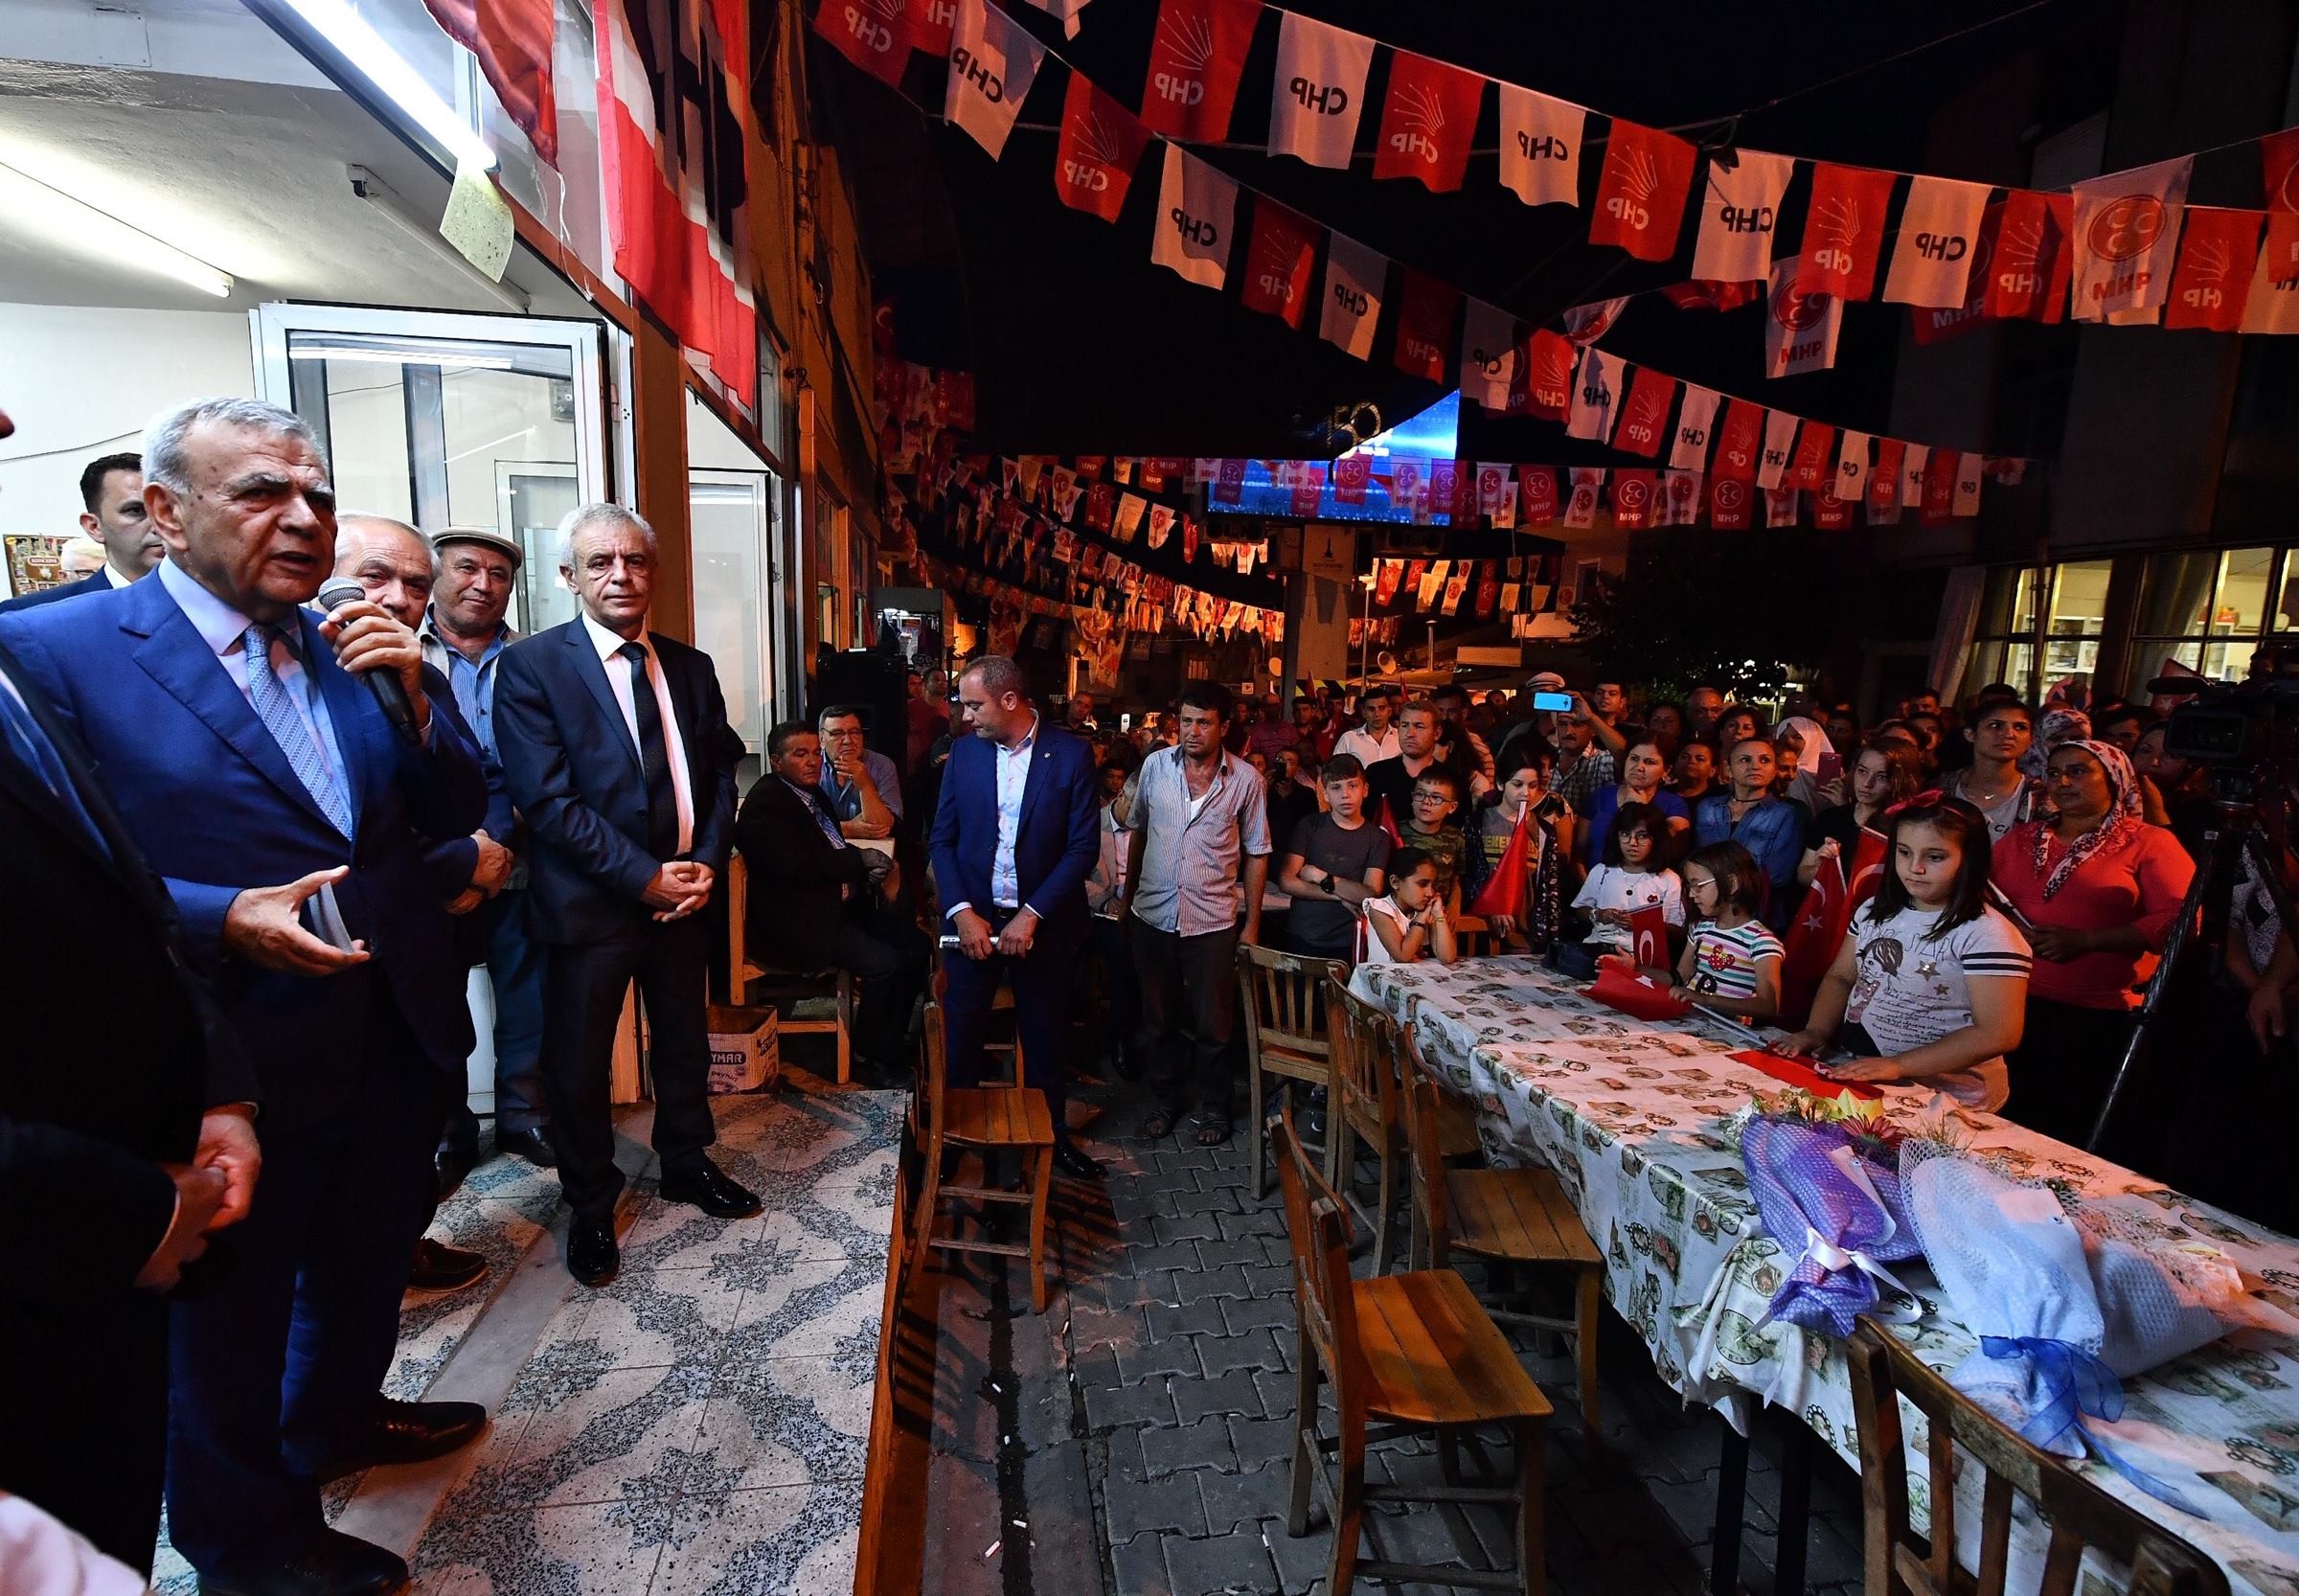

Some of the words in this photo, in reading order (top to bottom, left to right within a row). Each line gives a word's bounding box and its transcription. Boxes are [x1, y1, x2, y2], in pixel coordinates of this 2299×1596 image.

[2092, 272, 2151, 300] MHP
[1780, 341, 1822, 363] MHP
[1508, 393, 1525, 407] HP
[1531, 501, 1551, 513] MHP
[1619, 513, 1642, 521] MHP
[1717, 514, 1740, 523] MHP
[1821, 513, 1843, 522] MHP
